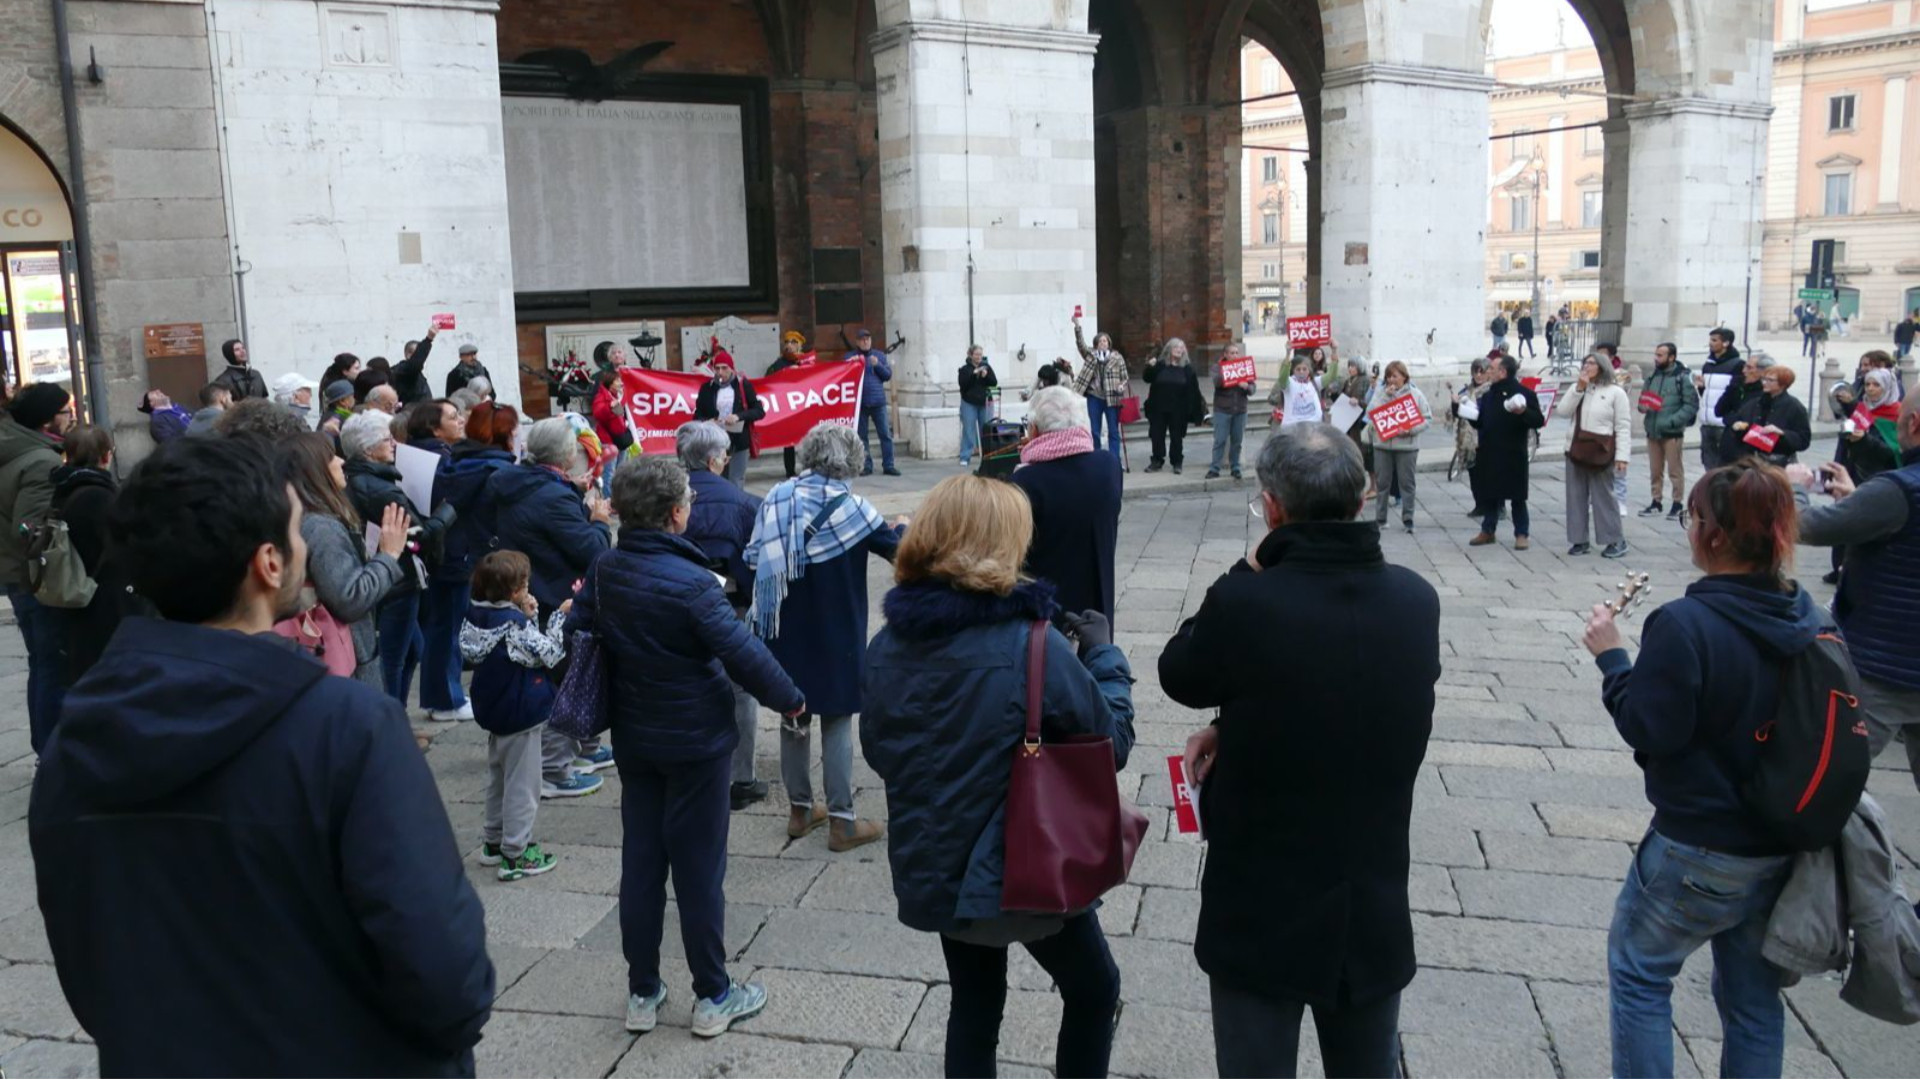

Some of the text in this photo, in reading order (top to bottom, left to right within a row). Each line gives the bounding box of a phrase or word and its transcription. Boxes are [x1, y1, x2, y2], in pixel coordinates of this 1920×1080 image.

[1289, 318, 1329, 330] SPAZIO DI
[1289, 326, 1329, 342] PACE
[1223, 365, 1255, 381] PACE
[632, 392, 697, 416] SPA
[787, 382, 856, 411] PACE
[1373, 403, 1404, 420] SPAZIO
[1376, 405, 1420, 433] PACE
